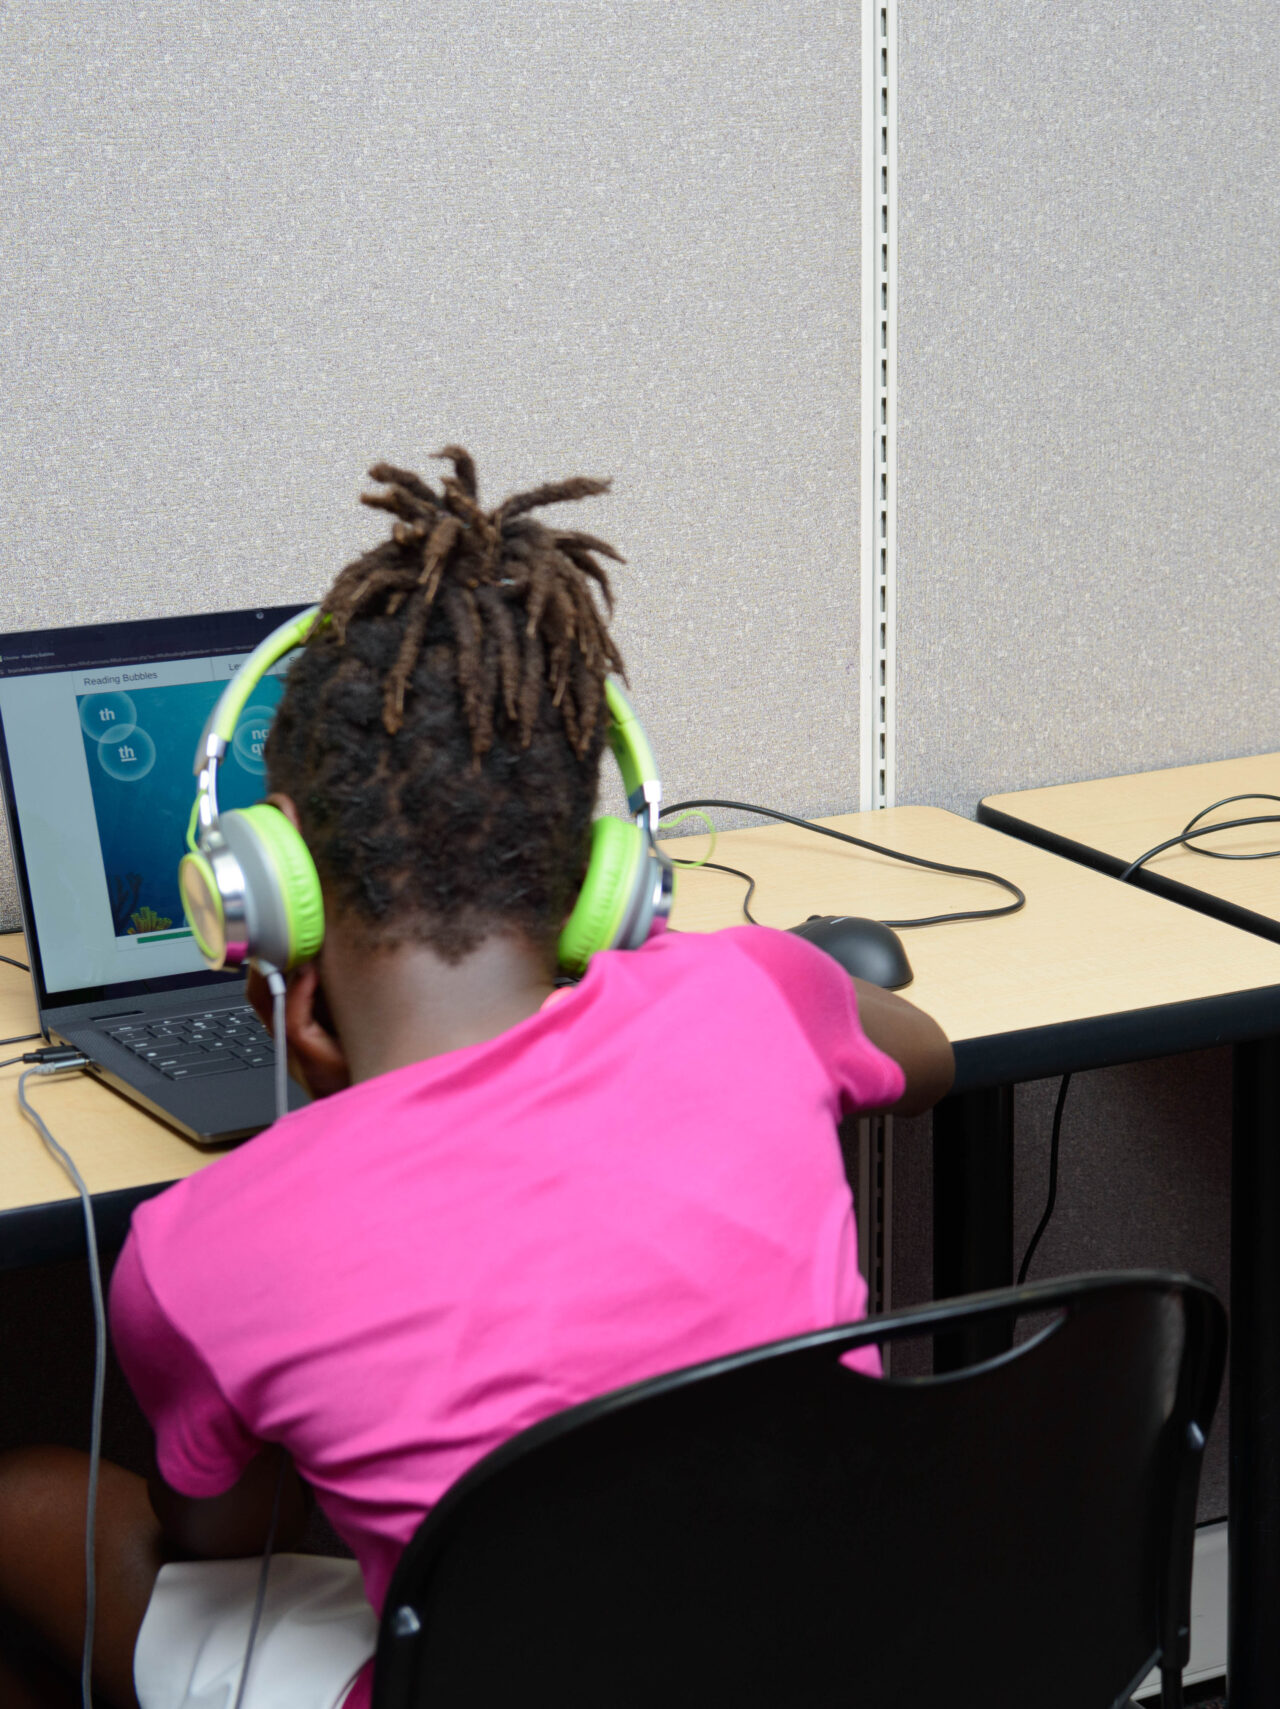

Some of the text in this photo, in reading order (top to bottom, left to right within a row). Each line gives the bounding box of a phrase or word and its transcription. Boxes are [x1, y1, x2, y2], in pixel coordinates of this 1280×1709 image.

[84, 672, 158, 687] Reading Bubbles
[99, 708, 116, 721] th
[118, 744, 136, 760] th
